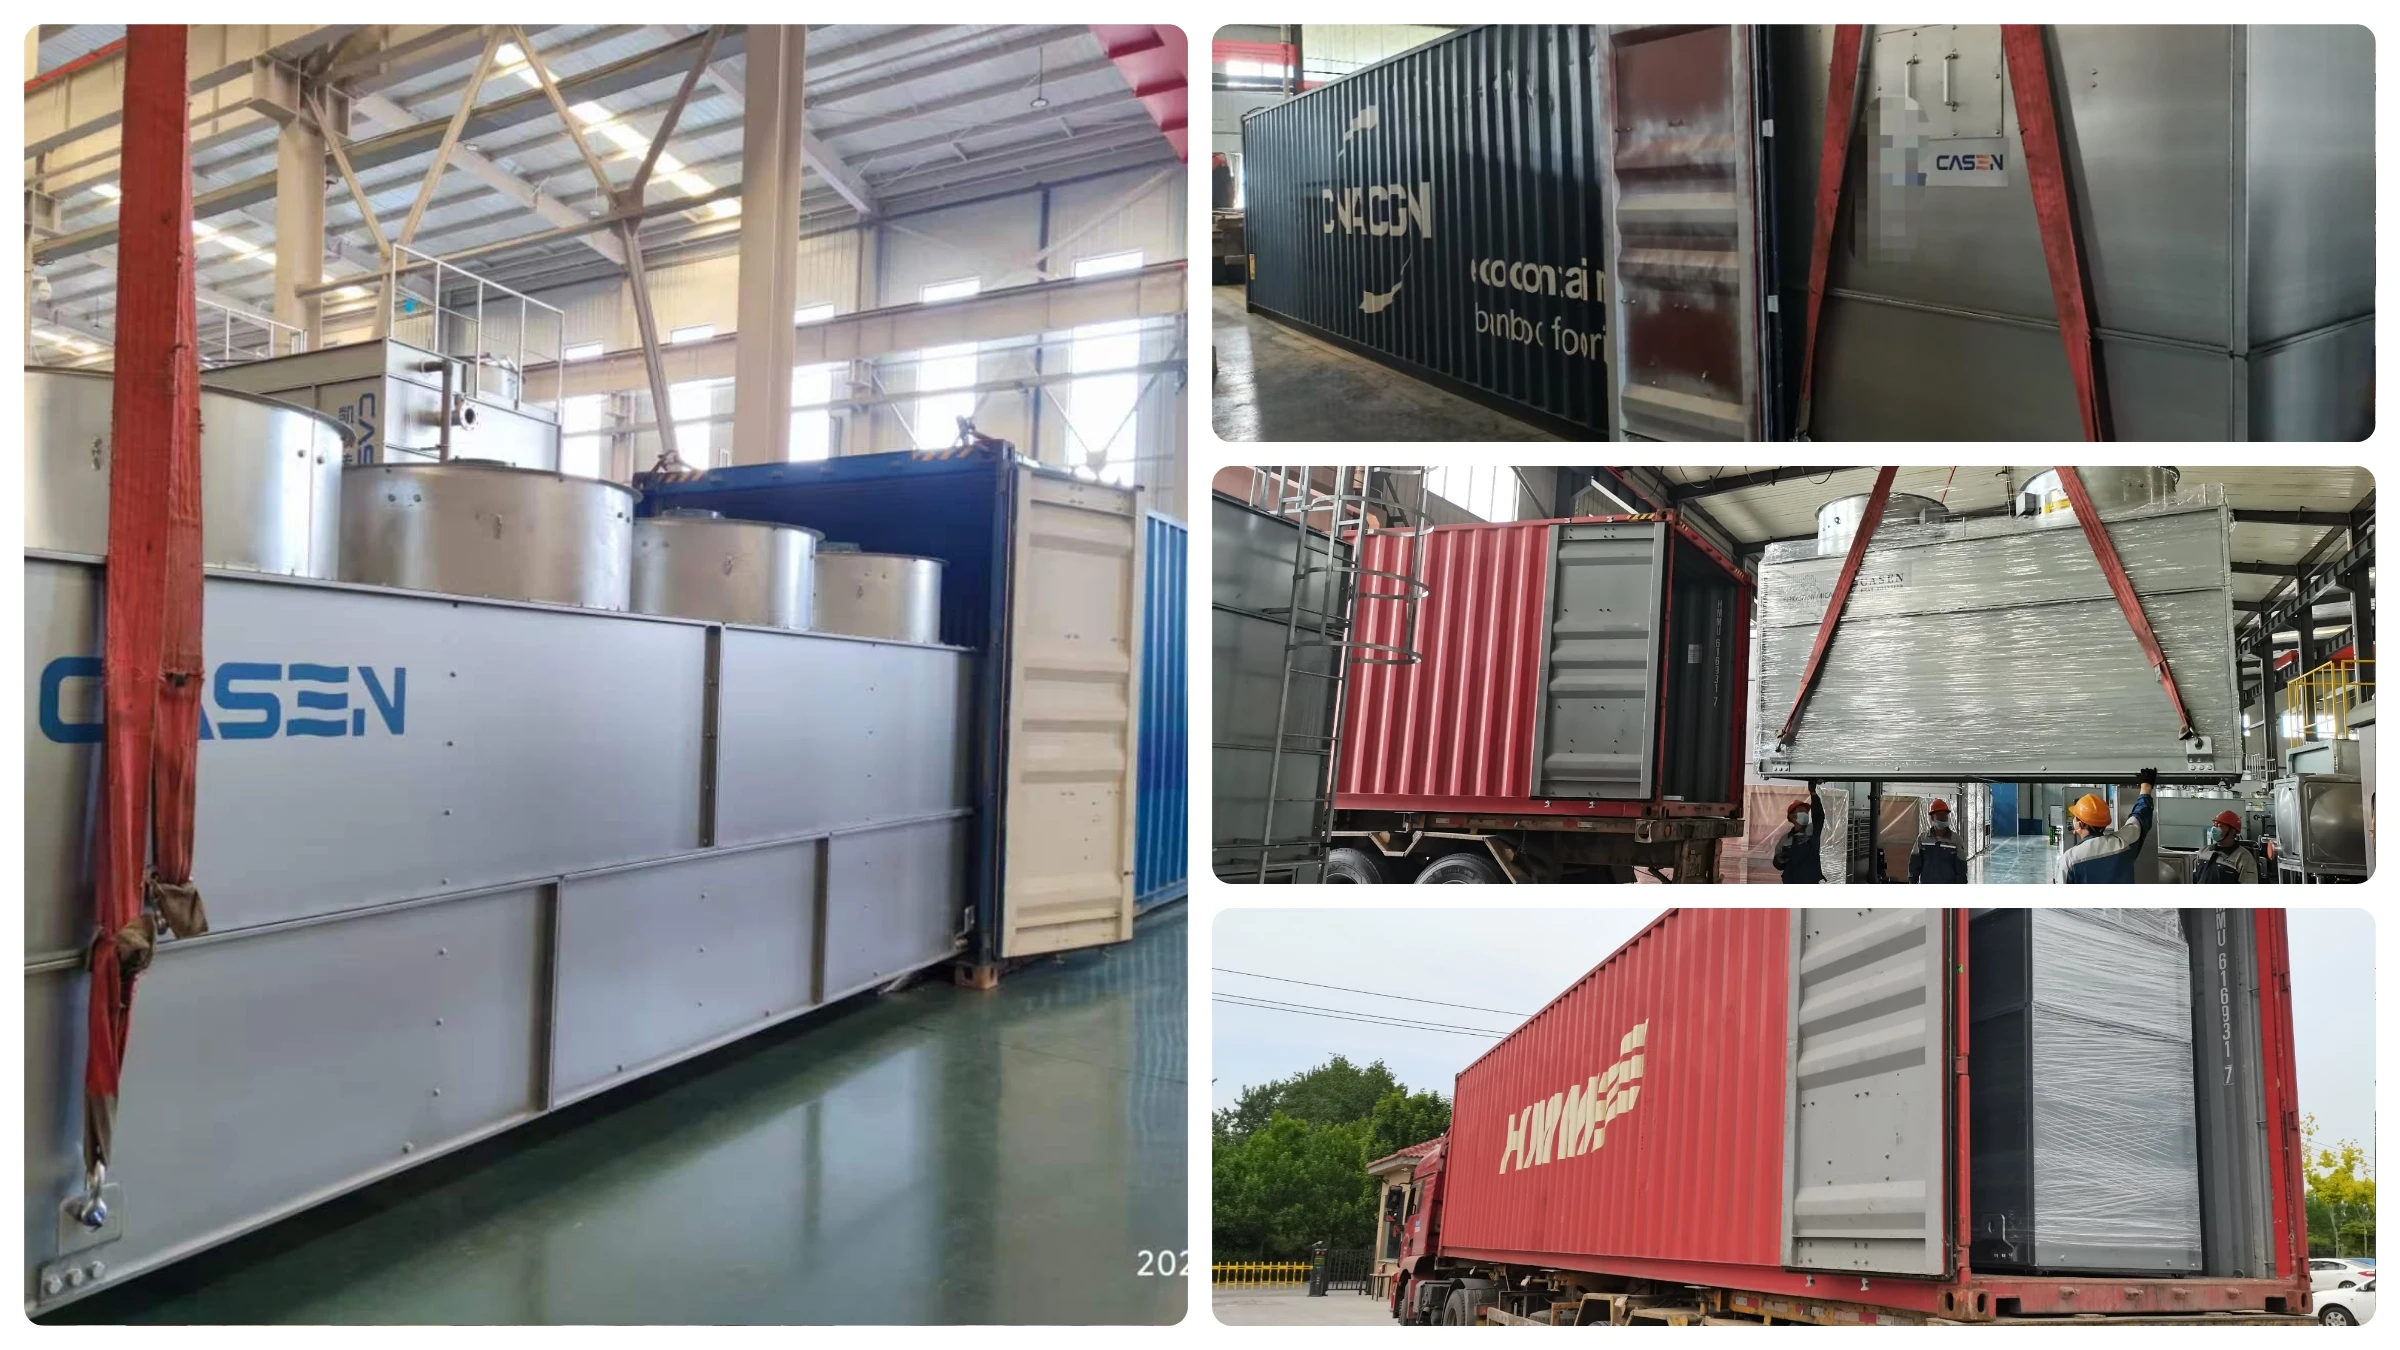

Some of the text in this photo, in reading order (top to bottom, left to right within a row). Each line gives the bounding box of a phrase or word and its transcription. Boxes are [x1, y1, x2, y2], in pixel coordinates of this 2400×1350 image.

[1936, 154, 2003, 171] CASEN
[39, 656, 406, 744] CSEN
[2218, 952, 2231, 1058] 616931
[2224, 1065, 2233, 1084] 7
